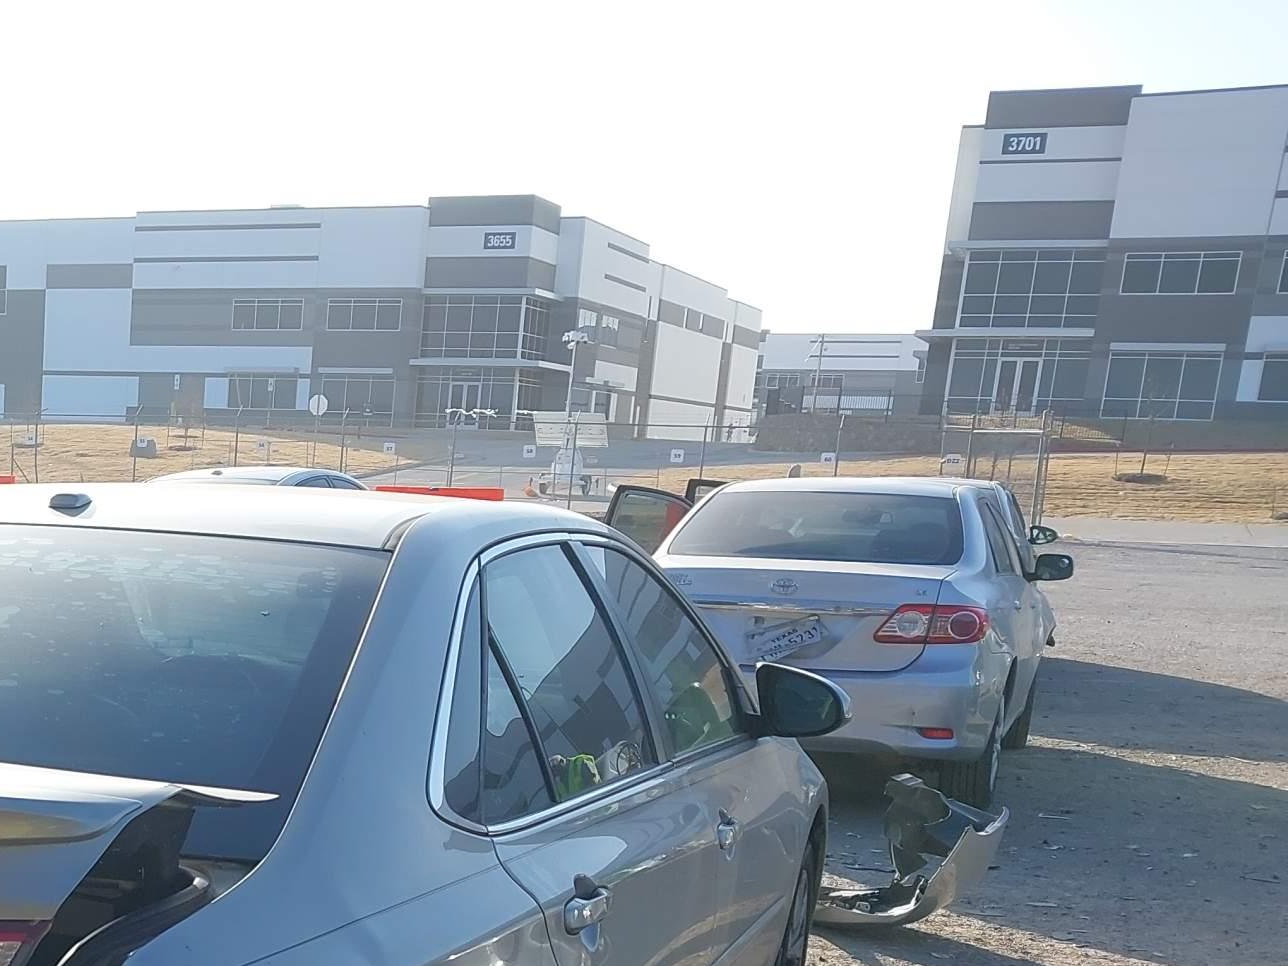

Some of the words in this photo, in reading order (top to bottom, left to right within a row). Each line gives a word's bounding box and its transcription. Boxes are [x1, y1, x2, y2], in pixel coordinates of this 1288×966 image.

[1008, 136, 1041, 151] 3701
[487, 235, 513, 247] 3655
[771, 628, 799, 643] TEXAS
